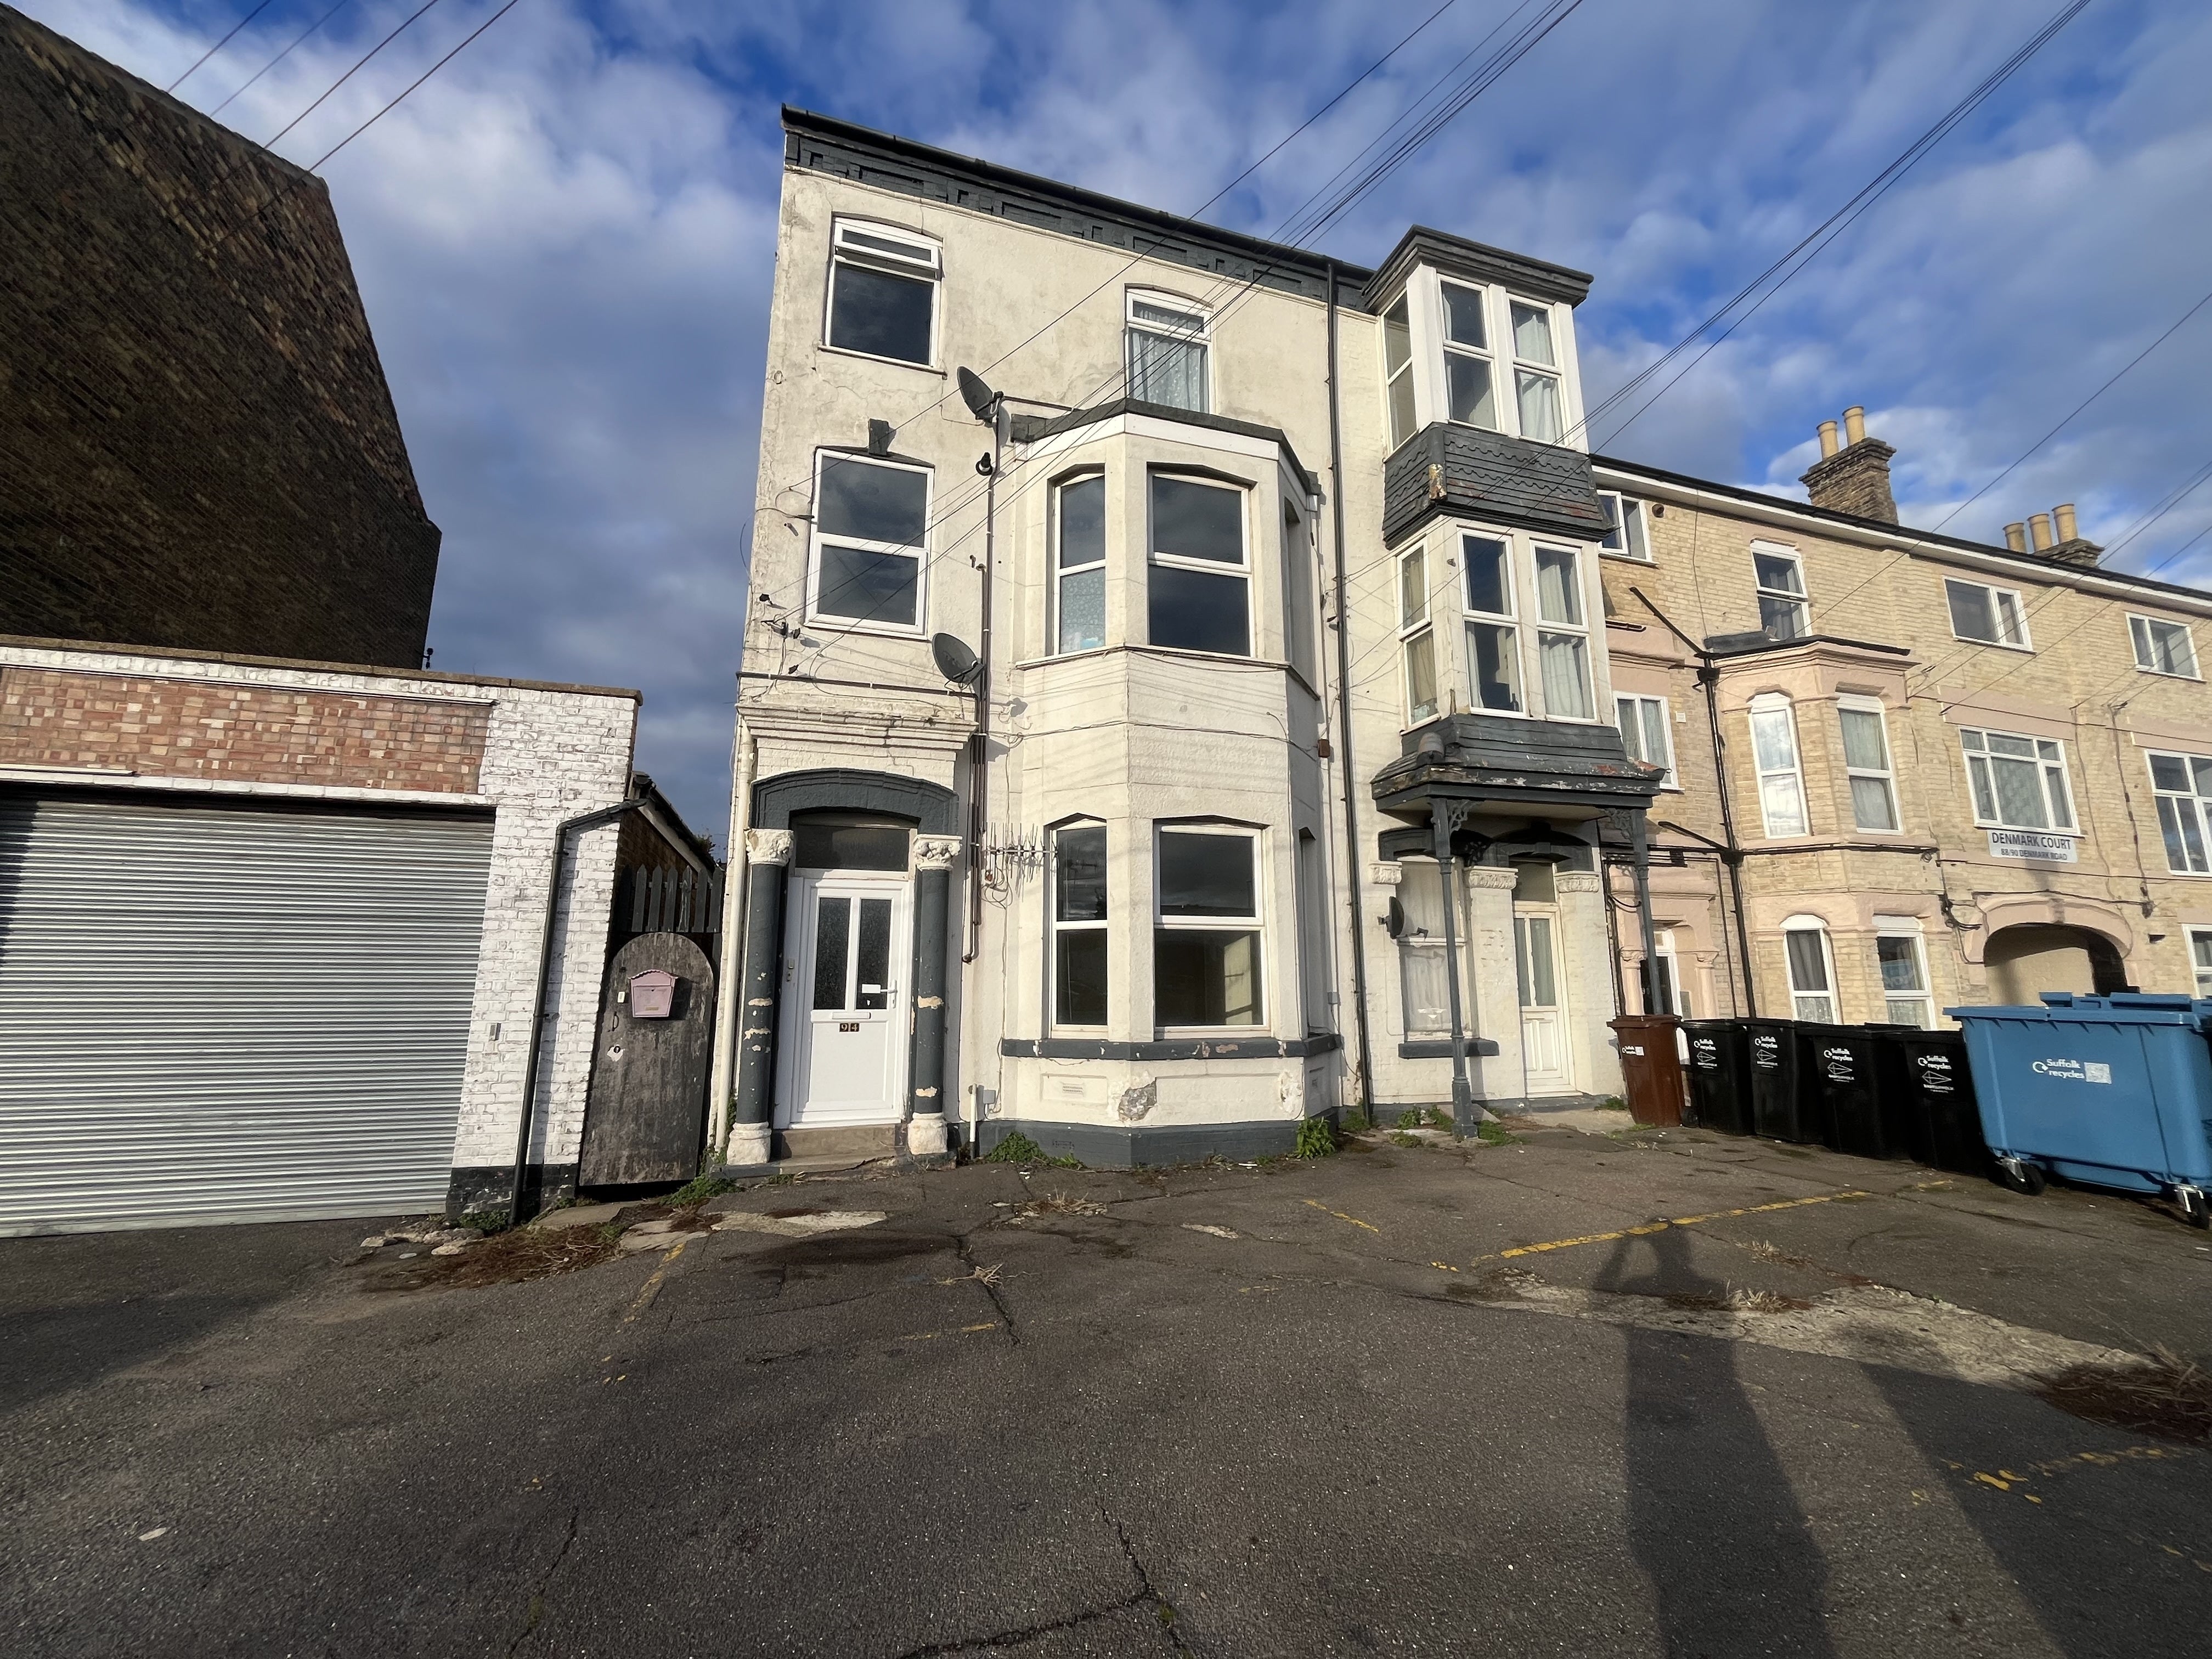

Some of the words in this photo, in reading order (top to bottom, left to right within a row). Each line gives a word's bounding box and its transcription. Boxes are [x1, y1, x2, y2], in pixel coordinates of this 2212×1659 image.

[1991, 832, 2040, 847] DENMARK
[2041, 837, 2071, 849] COURT
[2019, 849, 2049, 859] DENMARK
[2050, 852, 2068, 860] ROAD
[2046, 1058, 2081, 1069] Suffolk
[2048, 1070, 2085, 1079] recycles
